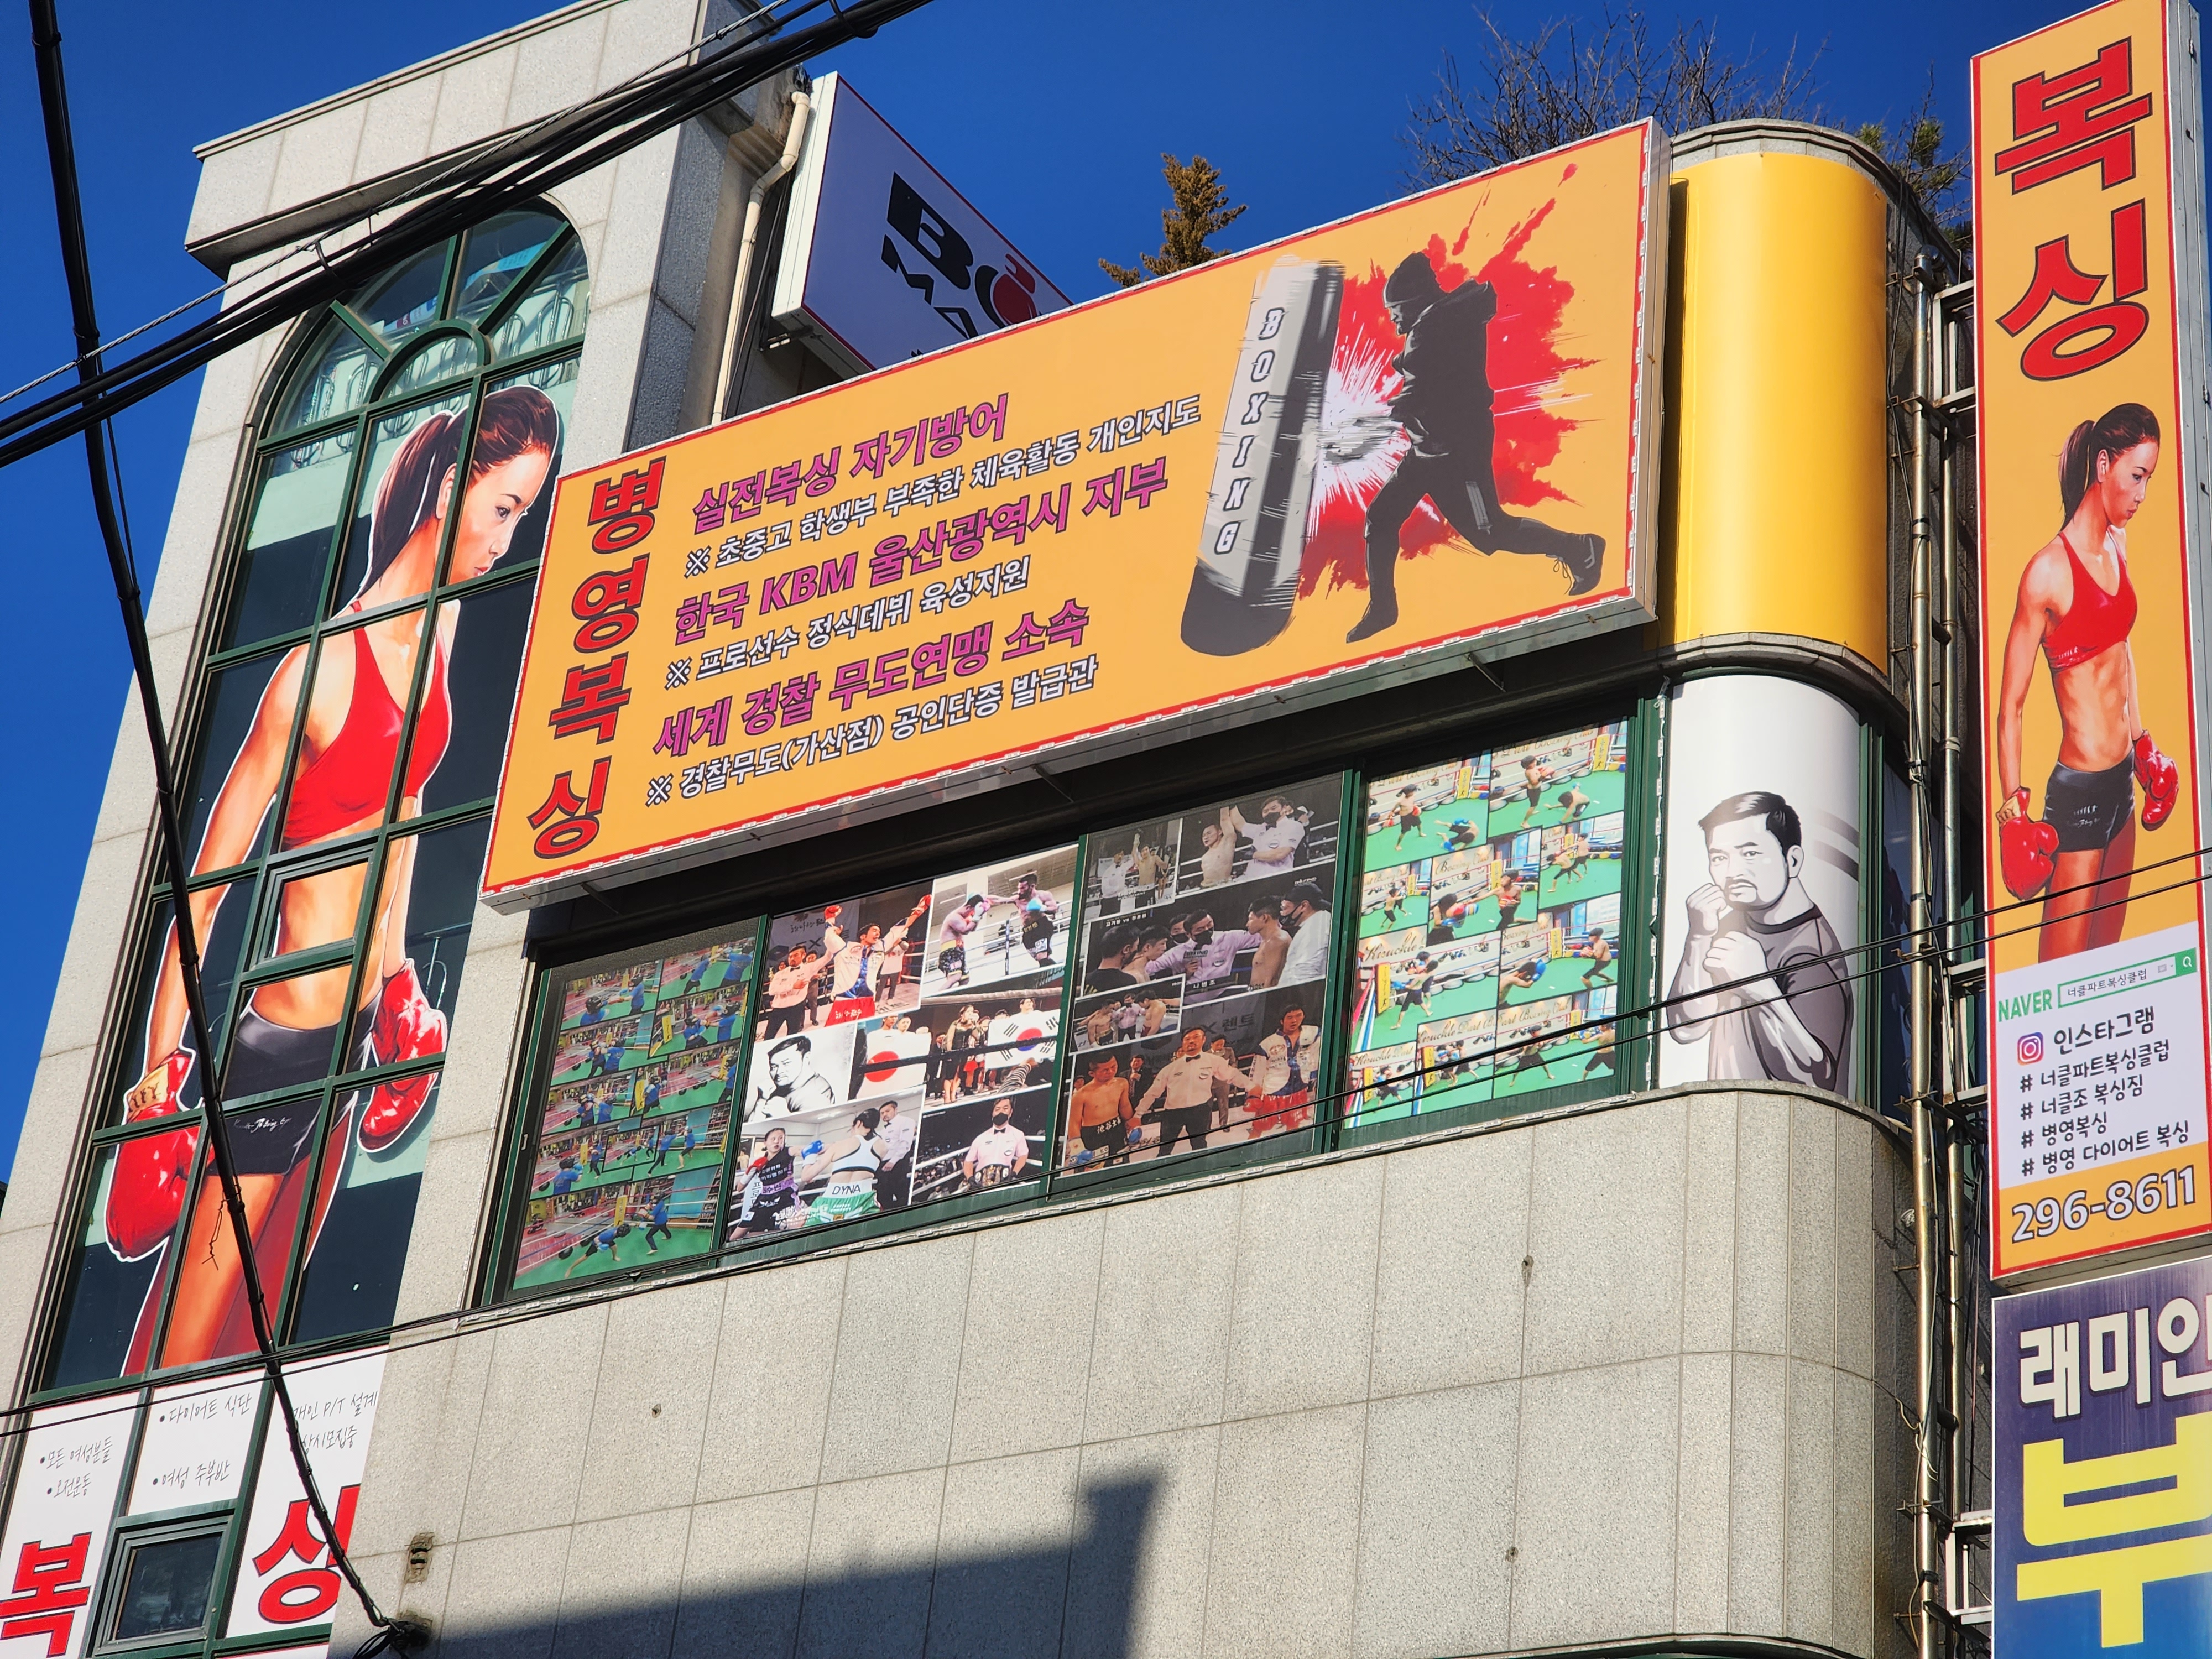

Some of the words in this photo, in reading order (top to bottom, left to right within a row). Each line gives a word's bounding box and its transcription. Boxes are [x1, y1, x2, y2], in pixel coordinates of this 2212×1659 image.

[1995, 35, 2153, 382] 복싱
[1214, 307, 1286, 555] BOXING
[693, 447, 839, 535] 실전복싱
[849, 393, 1009, 480] 자기방어
[716, 521, 791, 568] 초중고
[799, 495, 877, 542] 학생부
[883, 471, 964, 515] 부족한
[969, 431, 1080, 489] 체육활동
[1087, 393, 1201, 452] 개인지도
[675, 586, 750, 646] 한국
[760, 551, 858, 615] KBM
[868, 484, 1072, 585] 울산광역시
[1083, 455, 1169, 518] 지부
[696, 628, 800, 679] 프로선수
[807, 591, 911, 650] 정식데뷔
[919, 555, 1030, 614] 육성지원
[527, 456, 666, 859] 병영복싱
[653, 696, 732, 759] 세계
[742, 671, 819, 728] 경찰
[828, 622, 992, 712] 무도연맹
[1001, 597, 1090, 663] 소속
[679, 710, 883, 799] 경찰무도(가산점)
[891, 681, 1004, 741] 공인단증
[1011, 654, 1098, 711] 발급관
[1997, 988, 2053, 1022] NAVER
[2067, 968, 2148, 999] 너클파트복싱클럽
[2053, 1005, 2156, 1055] 인스타그램
[2040, 1039, 2171, 1088] 너클파트복싱클럽
[2041, 1088, 2089, 1117] 너클조
[2094, 1073, 2145, 1107] 복싱짐
[2042, 1110, 2108, 1147] 병영복싱
[2042, 1147, 2076, 1175] 병영
[2083, 1128, 2151, 1162] 다이어트
[2157, 1119, 2190, 1149] 복싱
[832, 1183, 861, 1196] DYNA
[2011, 1164, 2195, 1244] 296-8611
[169, 1401, 218, 1424] 다이어트
[224, 1393, 253, 1417] 식단
[292, 1401, 319, 1421] 개인
[322, 1397, 346, 1417] P/T
[350, 1391, 378, 1417] 설계
[46, 1447, 65, 1469] 모든
[70, 1436, 113, 1464] 여성분들
[301, 1425, 357, 1455] 상시모집중
[54, 1472, 92, 1498] 오전운동
[161, 1464, 189, 1487] 여성
[194, 1459, 231, 1482] 주부반
